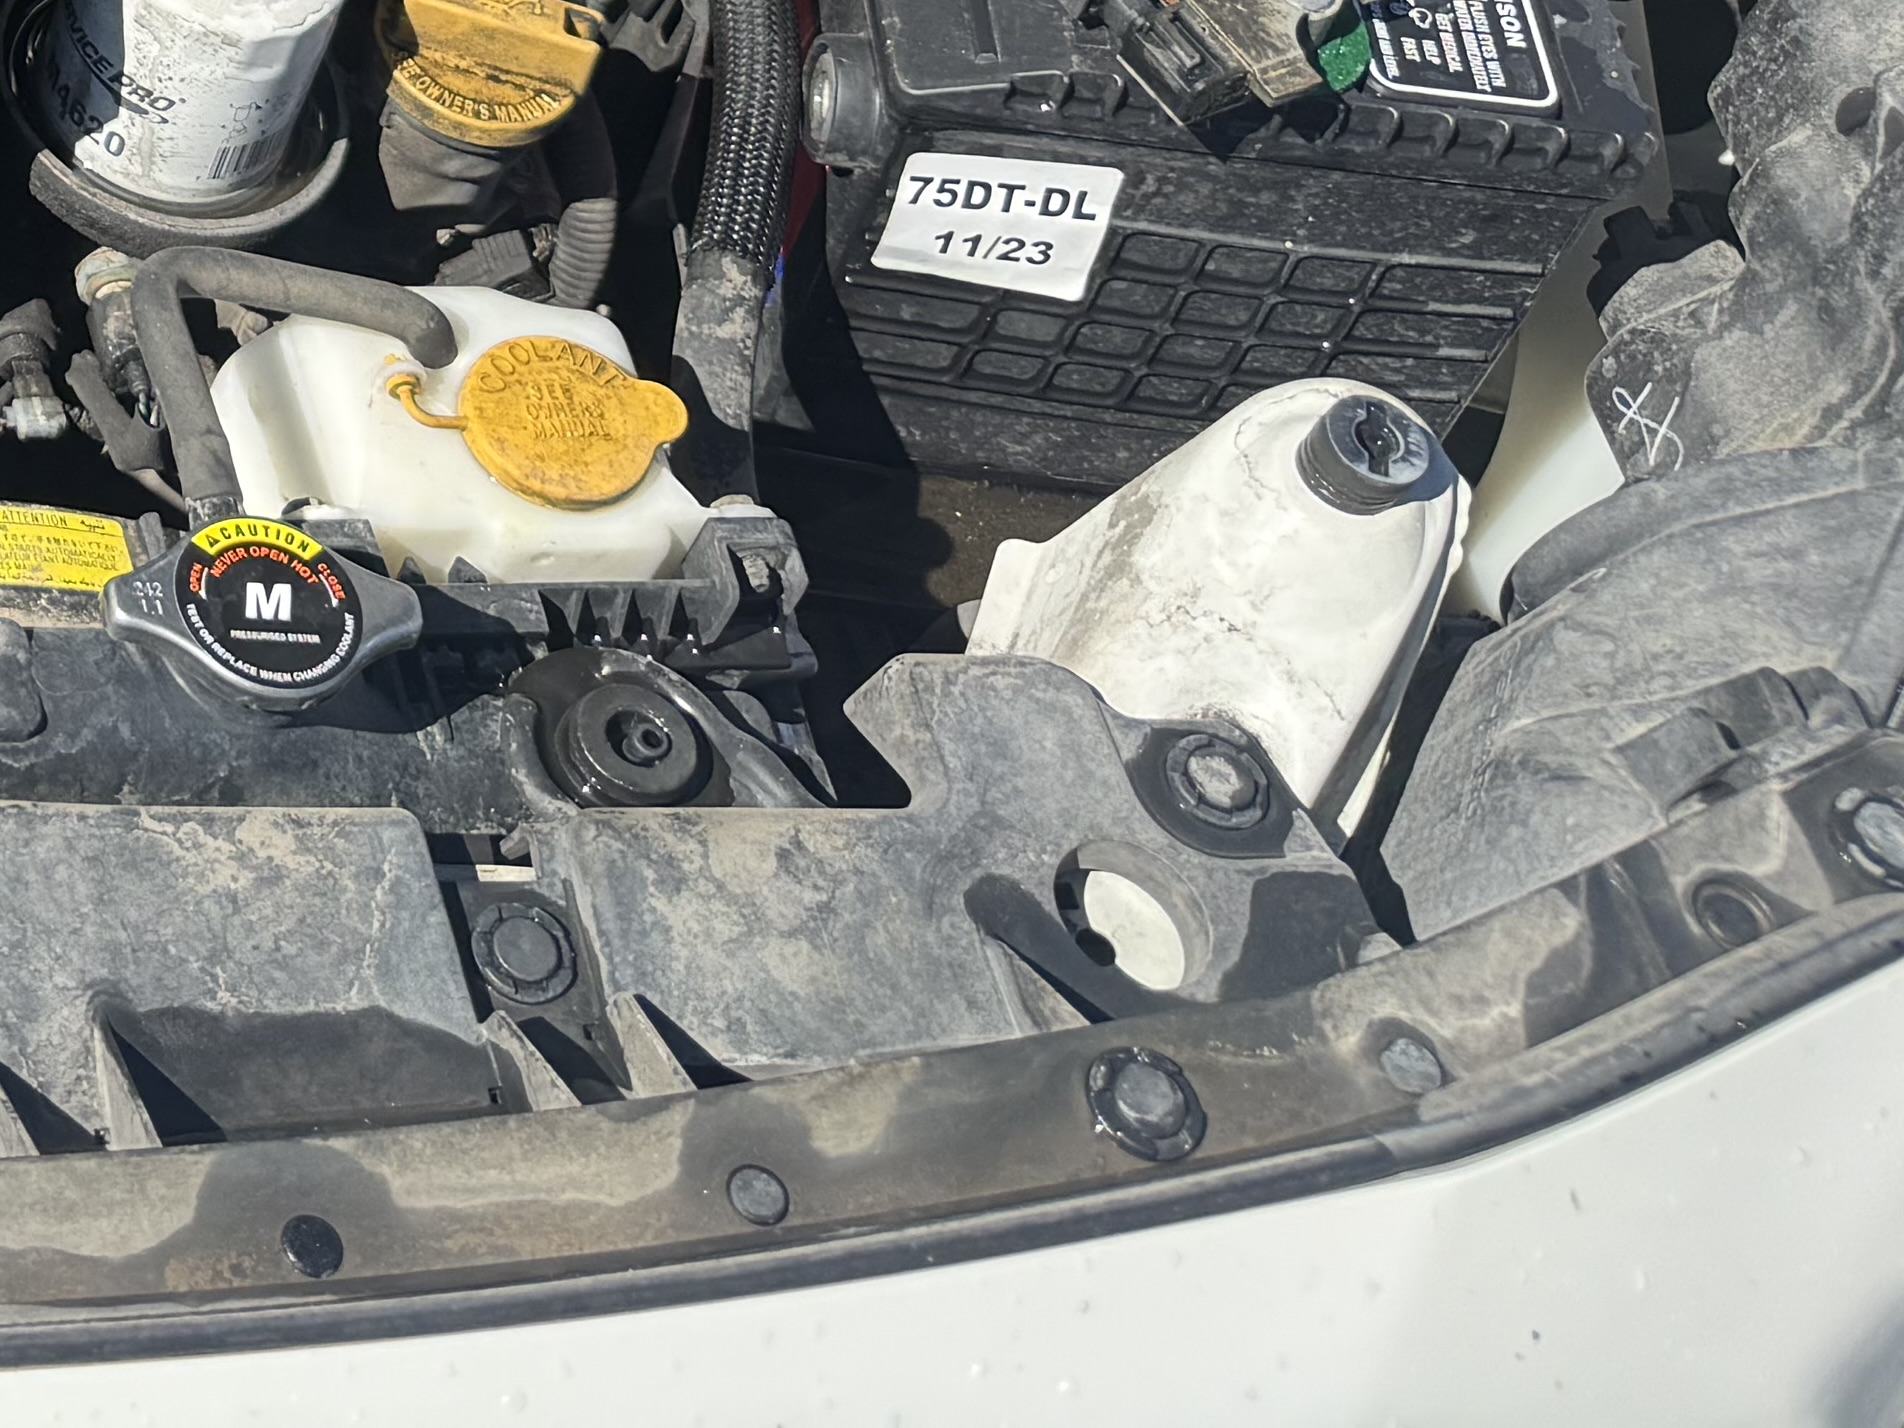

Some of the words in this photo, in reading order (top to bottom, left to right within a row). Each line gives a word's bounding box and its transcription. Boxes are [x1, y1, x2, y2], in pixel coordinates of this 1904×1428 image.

[1435, 13, 1453, 32] GET
[1468, 1, 1490, 33] FLUSH
[1401, 37, 1420, 62] FAST
[1422, 40, 1441, 65] HELP
[1478, 34, 1498, 59] EYES
[1486, 61, 1506, 87] WITH
[107, 70, 176, 111] PRO
[415, 76, 490, 121] OWNER'S
[495, 93, 561, 124] MANUAL
[908, 176, 1097, 221] 75DT-DL
[934, 230, 1054, 265] 11/23
[478, 339, 627, 394] COOLANT
[531, 419, 612, 439] MANUAL
[2, 509, 67, 527] ATTENTION
[221, 525, 310, 554] CAUTION
[189, 563, 202, 593] OPEN
[210, 546, 247, 578] NEVER
[250, 546, 289, 566] OPEN
[291, 560, 319, 585] HOT
[317, 563, 346, 601] CLOSE
[245, 582, 292, 622] M
[199, 628, 214, 645] OR
[212, 641, 257, 677] REPLACE
[259, 669, 292, 682] WHEN
[293, 653, 339, 681] CHANGING
[335, 612, 355, 657] COOLANT
